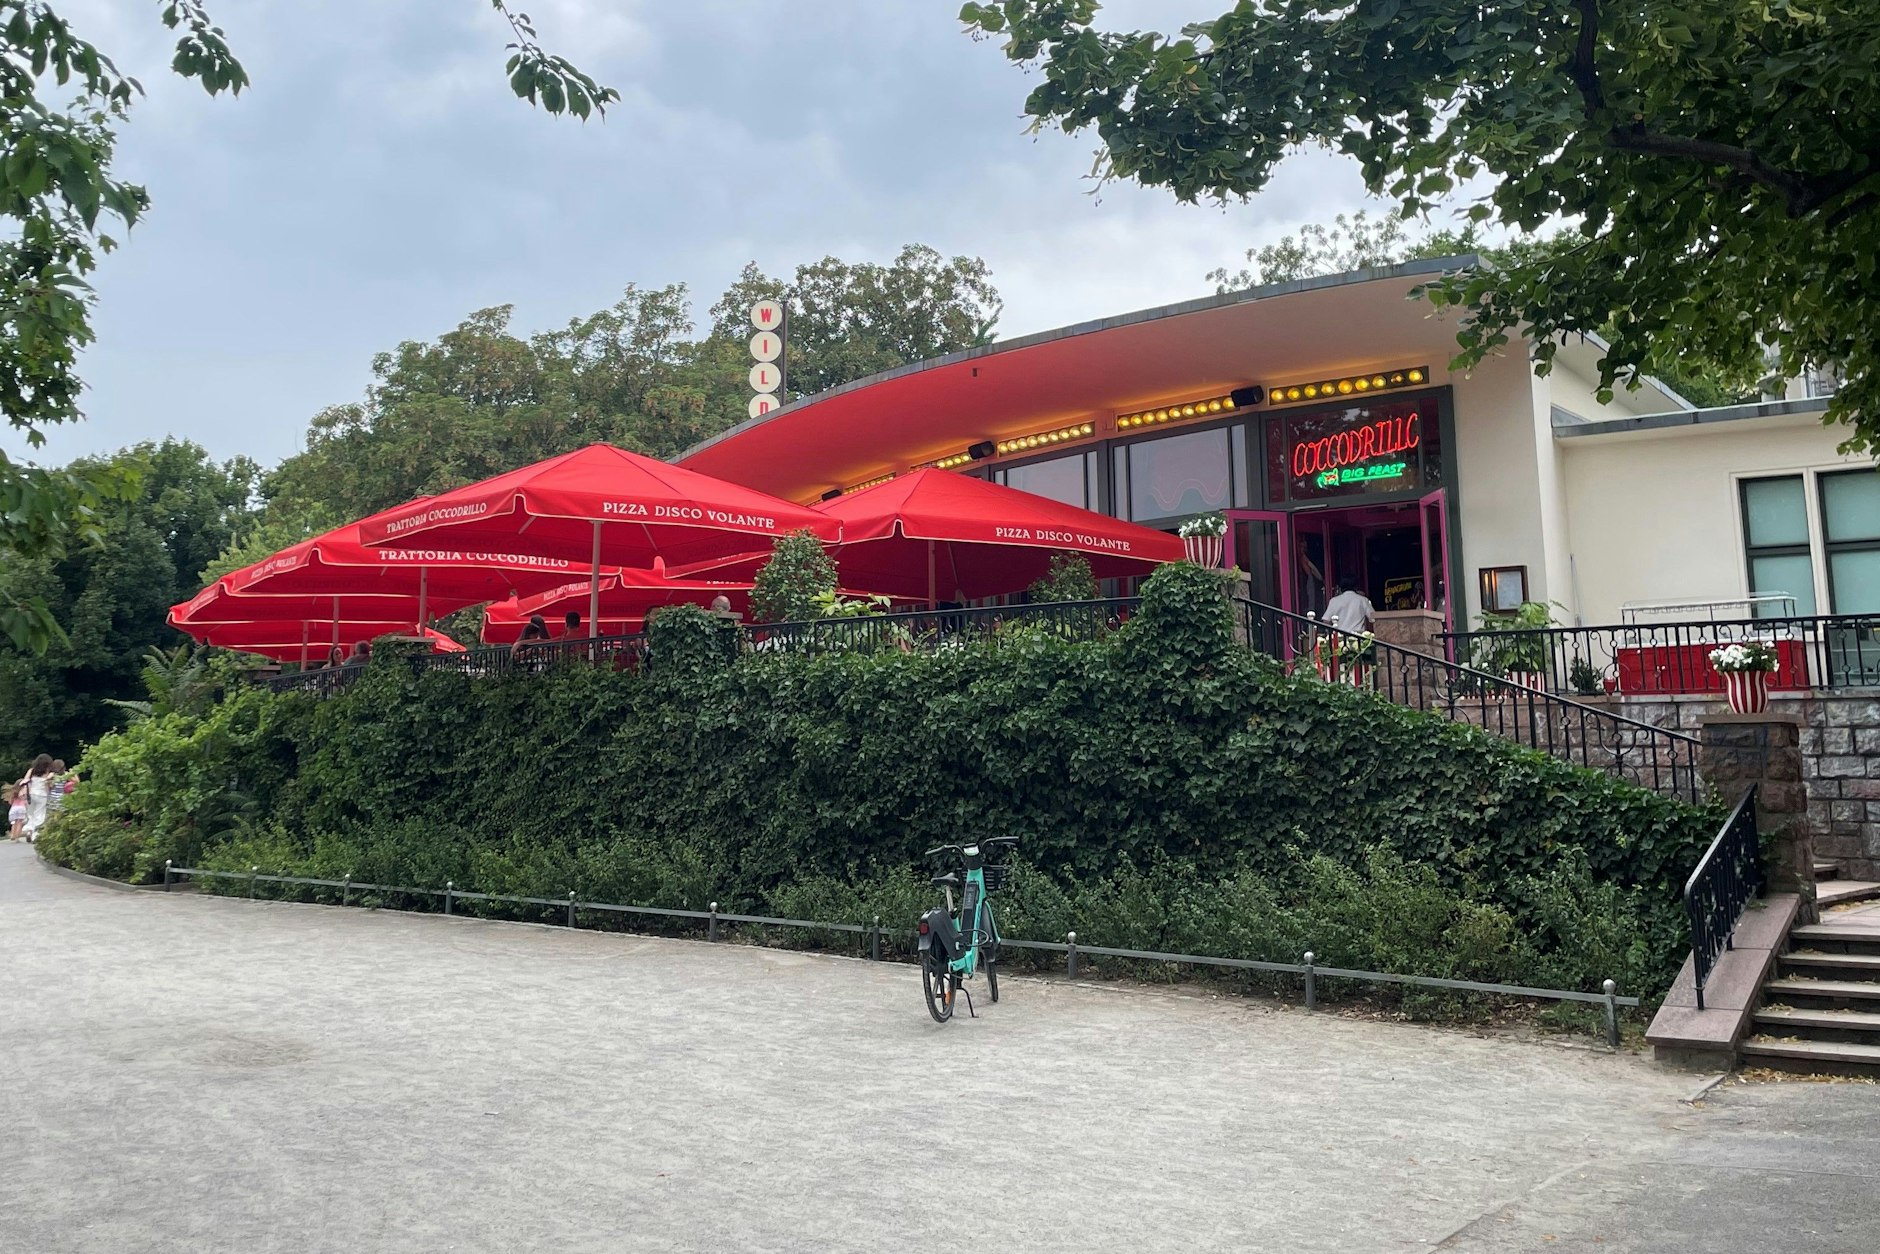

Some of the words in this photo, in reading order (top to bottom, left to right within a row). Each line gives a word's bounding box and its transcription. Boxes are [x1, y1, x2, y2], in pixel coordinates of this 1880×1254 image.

[1341, 468, 1365, 479] BIG
[1368, 462, 1406, 476] FEAST
[386, 513, 427, 534] TRATTORIA
[428, 502, 487, 522] COCCODRILLO
[603, 502, 648, 516] PIZZA
[655, 505, 702, 519] DISCO
[707, 510, 775, 529] VOLANTE
[996, 527, 1031, 539] PIZZA
[1036, 530, 1073, 543] DISCO
[1076, 534, 1131, 551] VOLANTE
[379, 550, 462, 561] TRATTORIA
[466, 551, 569, 568] COCCODRILLO
